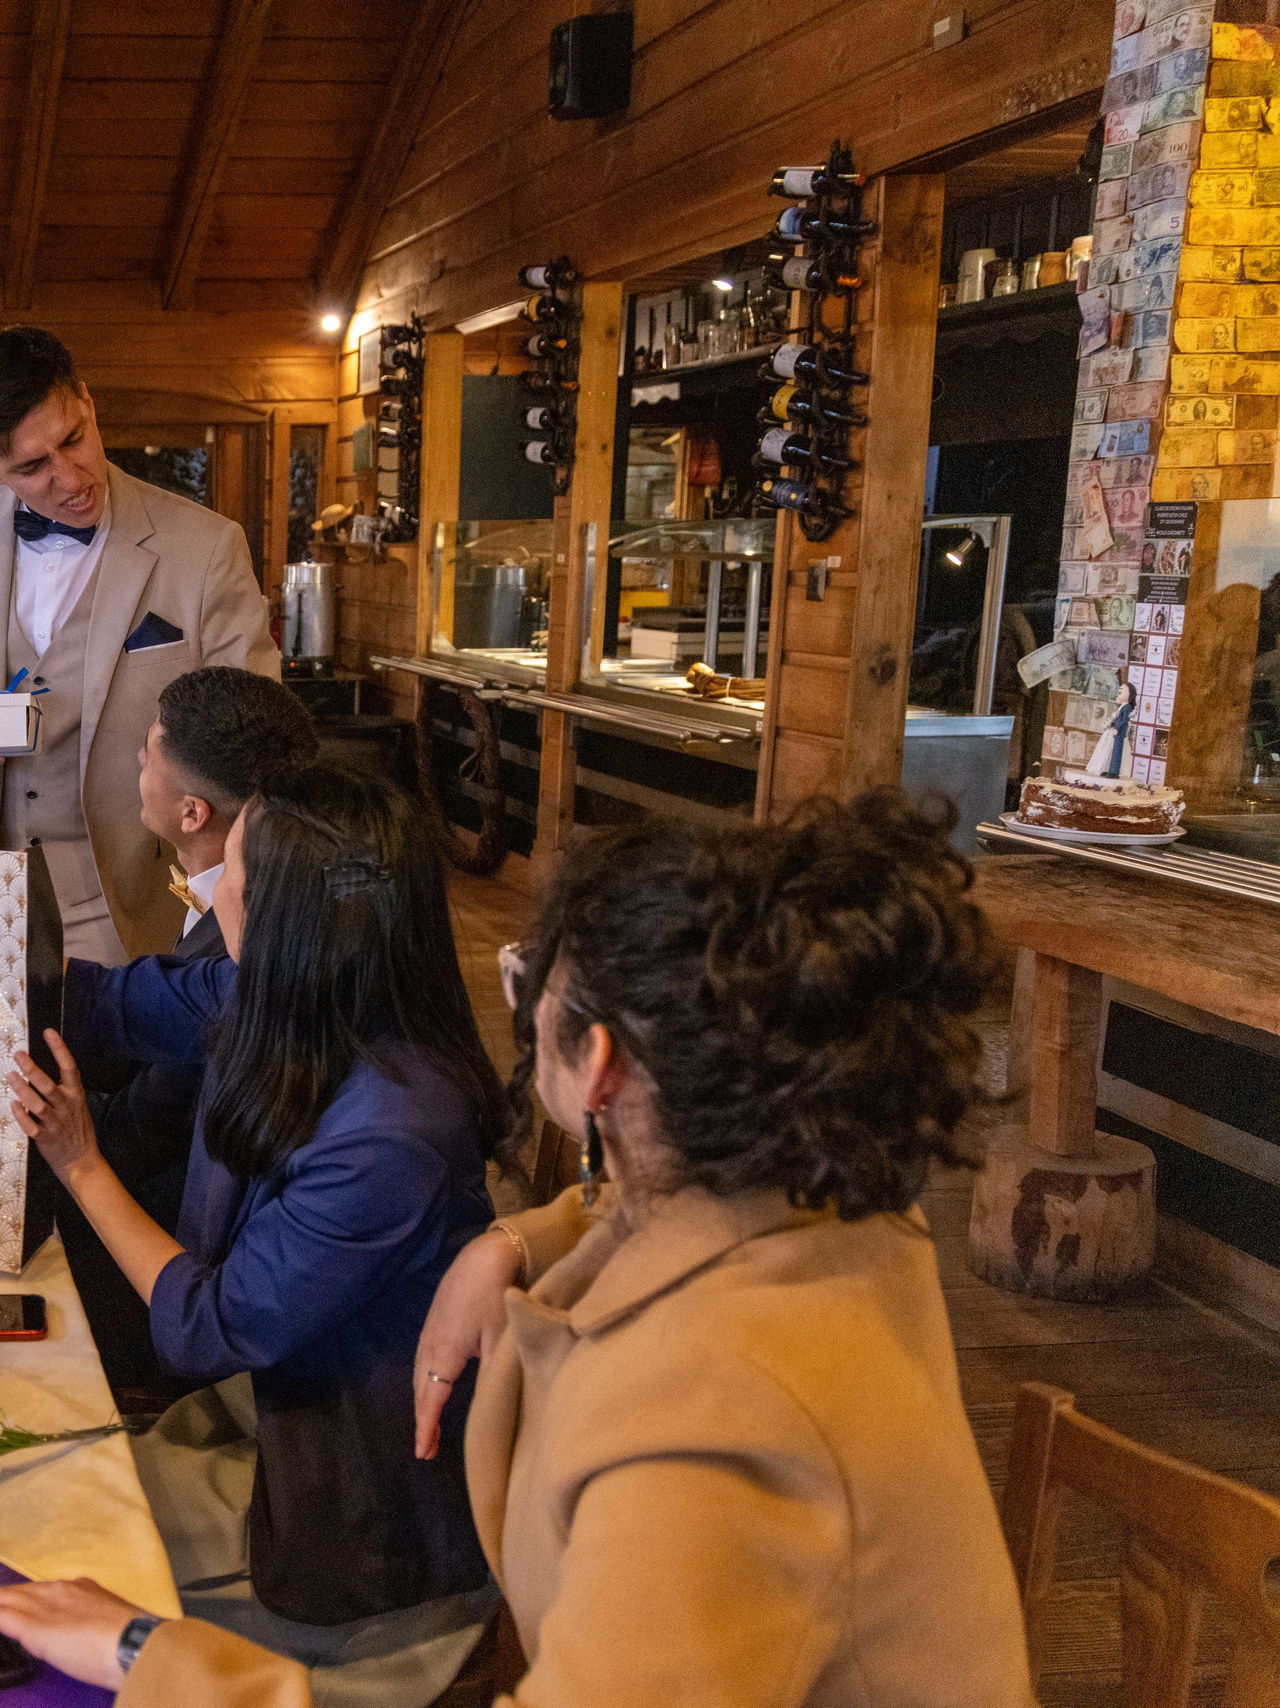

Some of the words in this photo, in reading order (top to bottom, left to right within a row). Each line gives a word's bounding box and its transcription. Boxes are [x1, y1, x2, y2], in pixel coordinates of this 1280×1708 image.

[1117, 127, 1129, 141] 20
[1168, 142, 1188, 155] 100
[1170, 215, 1180, 229] 5
